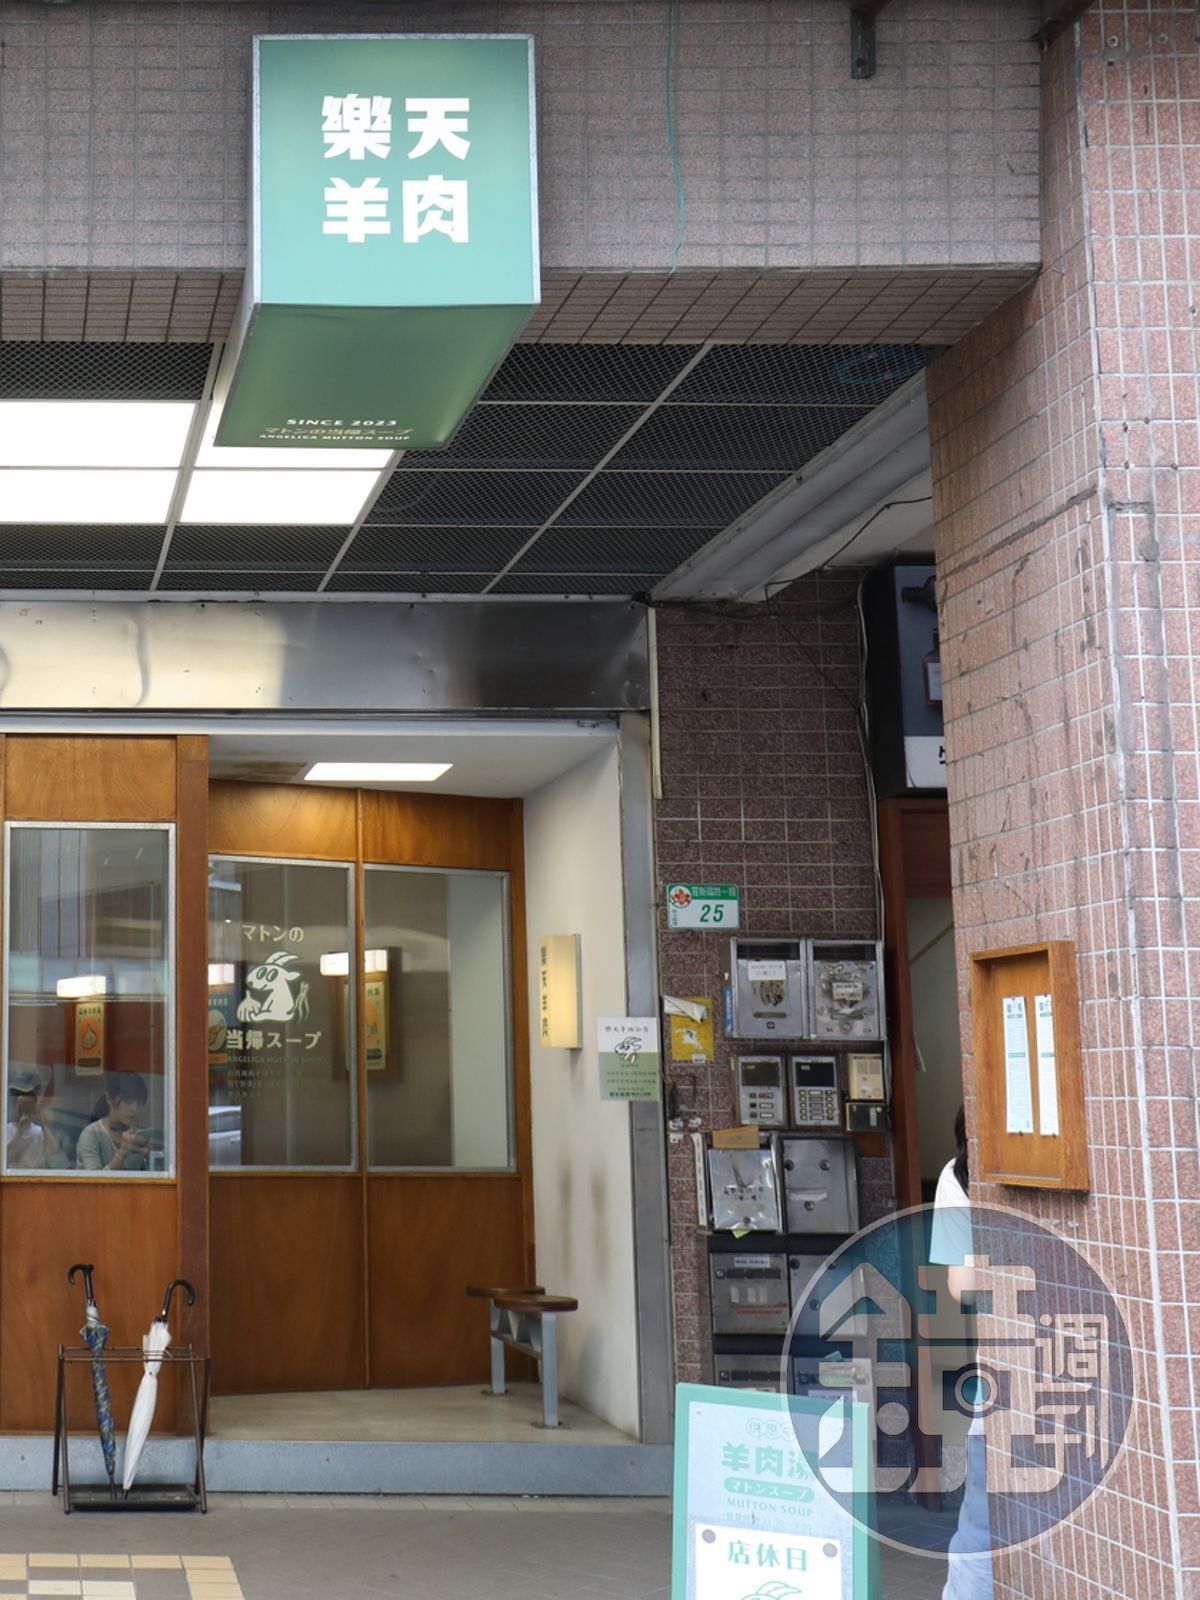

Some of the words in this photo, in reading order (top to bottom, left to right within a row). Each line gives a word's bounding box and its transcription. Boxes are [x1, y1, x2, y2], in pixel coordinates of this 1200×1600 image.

[321, 93, 471, 161] 樂天
[322, 174, 470, 243] 羊肉
[700, 904, 724, 922] 25
[242, 924, 304, 943] マトンの
[226, 1029, 322, 1049] 当帰スープ
[730, 1480, 808, 1500] マトンスープ
[727, 1497, 777, 1512] MUTTON
[781, 1504, 814, 1517] SOUP
[728, 1540, 807, 1571] 店休日
